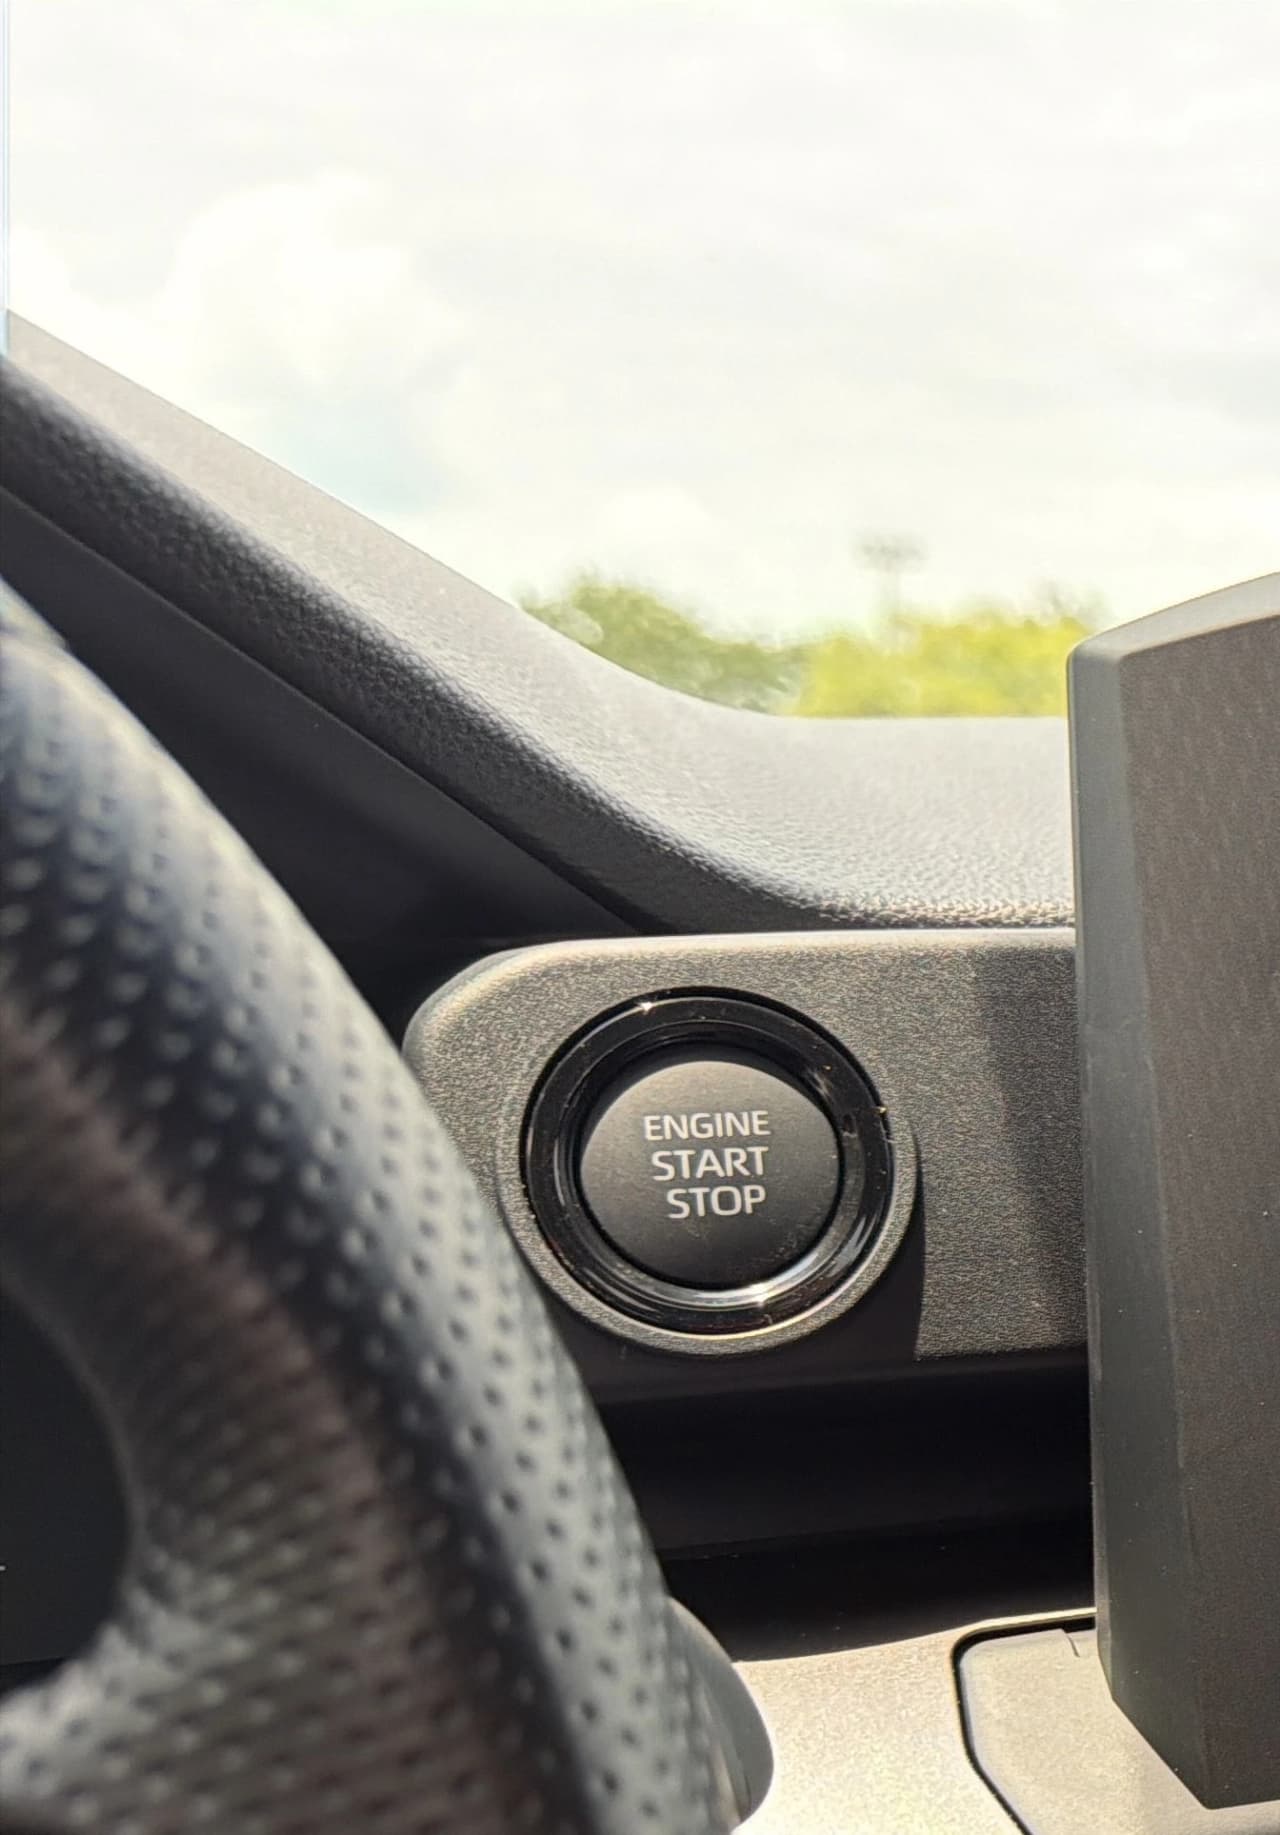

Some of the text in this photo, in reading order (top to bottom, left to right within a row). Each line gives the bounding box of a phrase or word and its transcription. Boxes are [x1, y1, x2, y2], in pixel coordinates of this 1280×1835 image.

[643, 1109, 772, 1141] ENGINE
[651, 1146, 769, 1181] START
[666, 1184, 766, 1219] STOP
